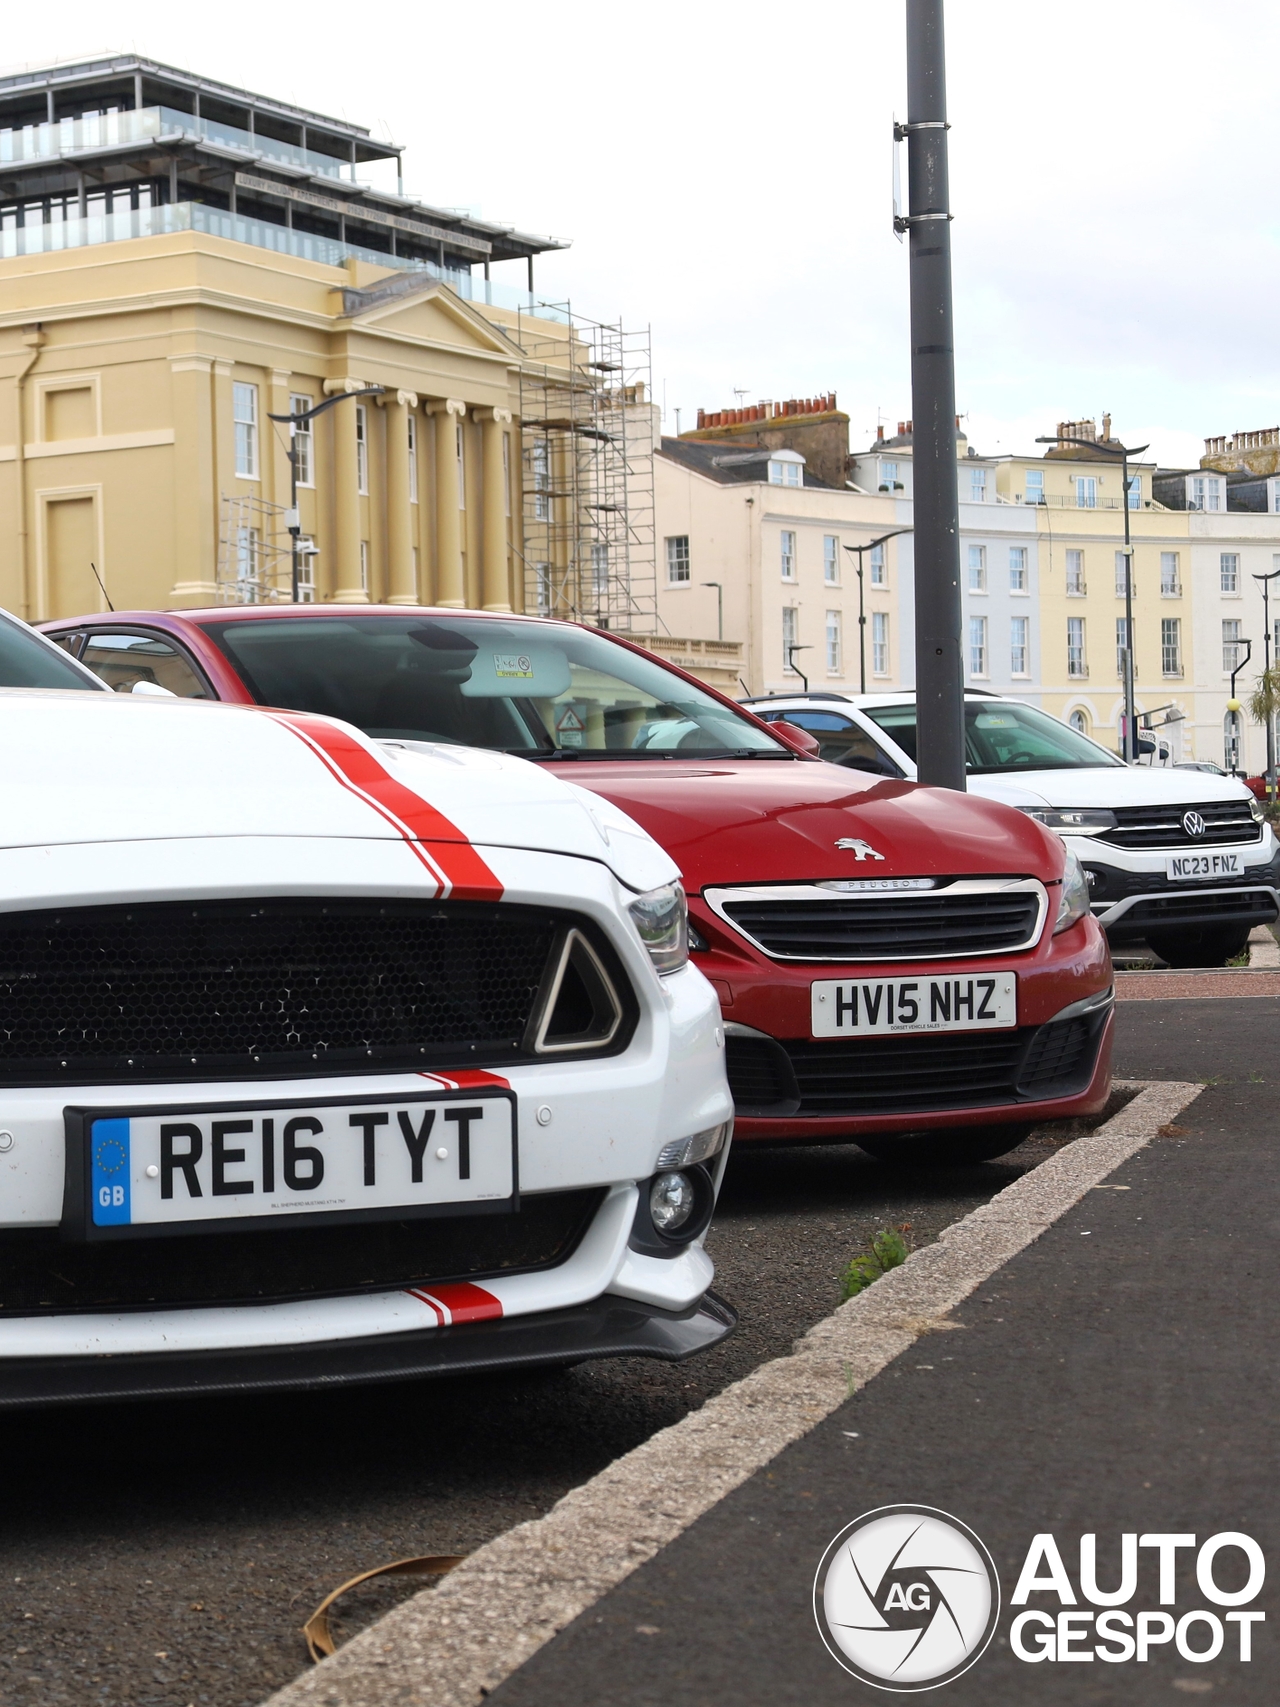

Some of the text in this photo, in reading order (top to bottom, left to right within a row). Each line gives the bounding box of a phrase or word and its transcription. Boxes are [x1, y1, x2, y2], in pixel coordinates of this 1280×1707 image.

[1172, 855, 1238, 876] NC23 FNZ
[848, 880, 920, 888] PEUGEOT
[836, 979, 996, 1027] HV15 NHZ
[160, 1106, 484, 1200] RE16 TYT
[99, 1186, 125, 1207] GB
